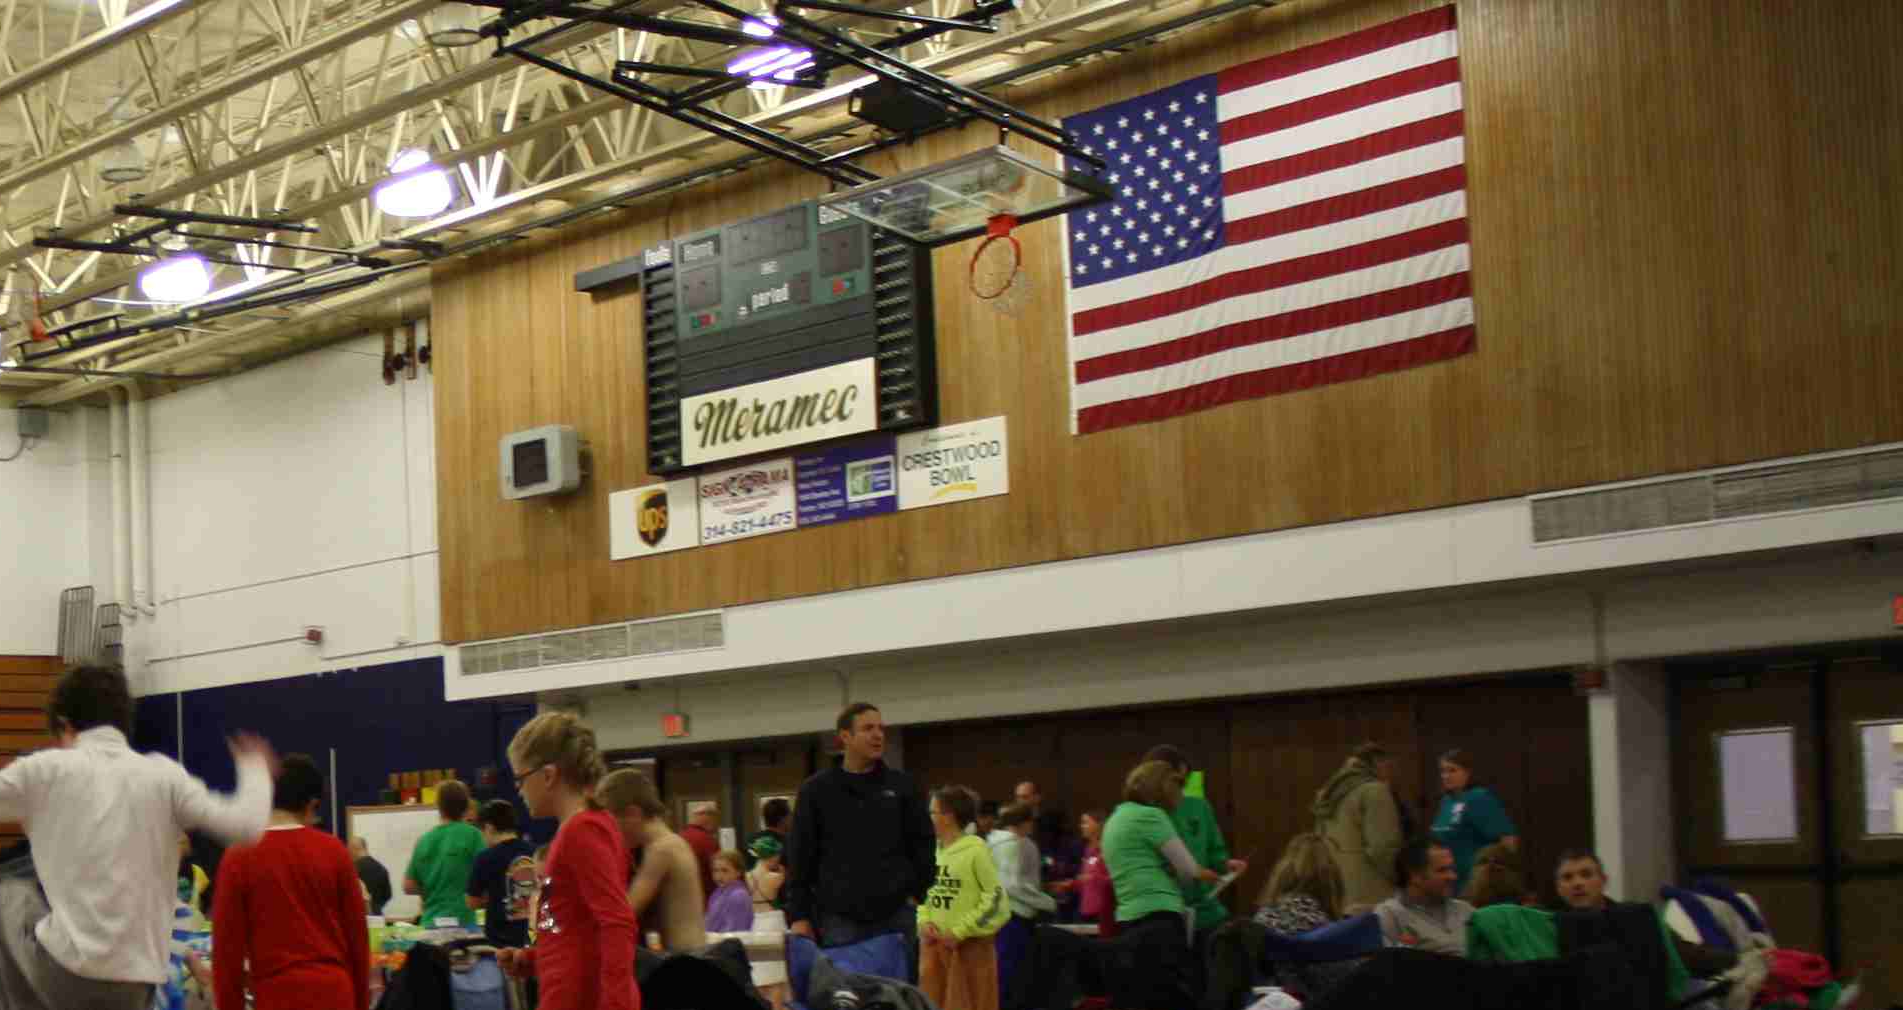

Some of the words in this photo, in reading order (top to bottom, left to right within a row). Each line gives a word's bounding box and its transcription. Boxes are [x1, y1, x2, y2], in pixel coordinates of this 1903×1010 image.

[694, 384, 858, 448] Meramec
[902, 440, 1001, 472] CRESTWOOD
[930, 464, 976, 487] BOWL
[639, 504, 668, 539] ups
